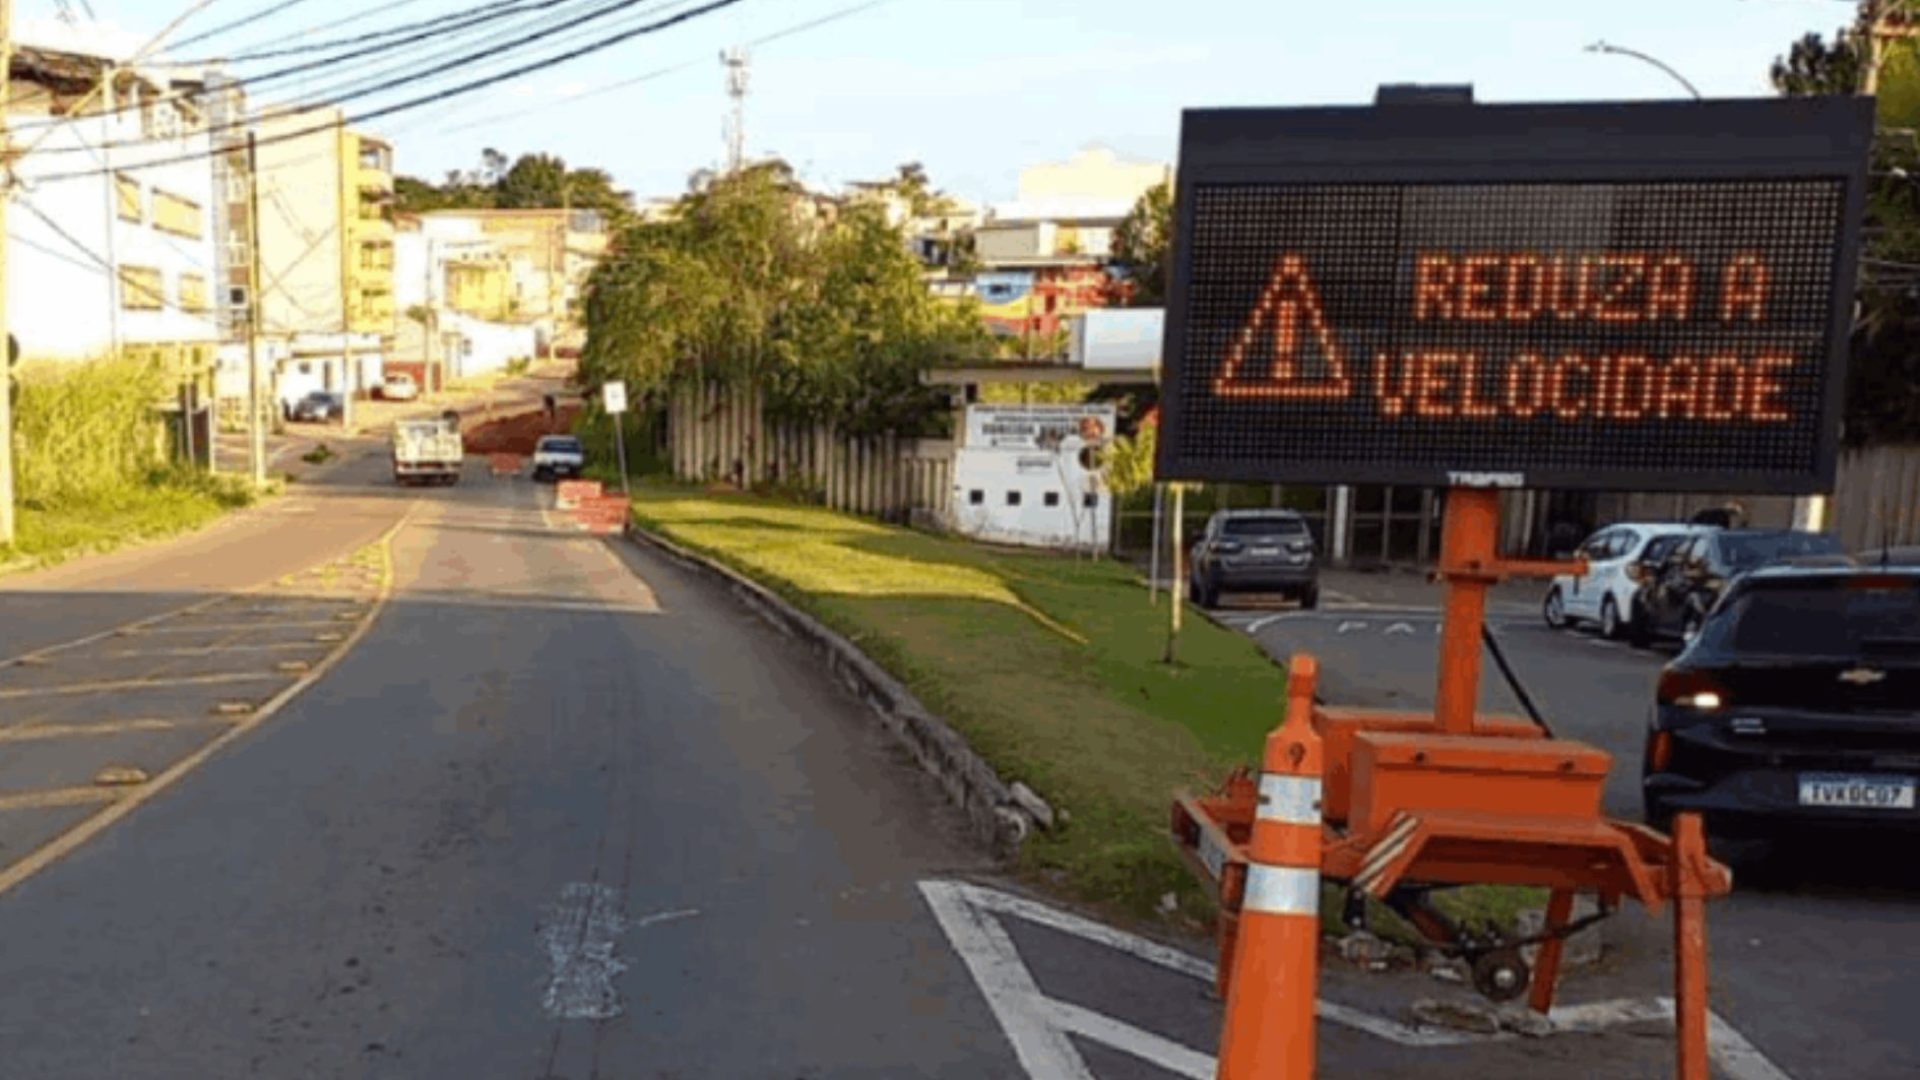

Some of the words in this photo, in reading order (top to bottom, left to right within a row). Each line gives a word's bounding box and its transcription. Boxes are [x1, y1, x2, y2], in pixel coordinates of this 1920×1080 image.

[1413, 252, 1693, 323] REDUZA
[1718, 252, 1770, 322] A
[1374, 350, 1797, 421] VELOCIDADE
